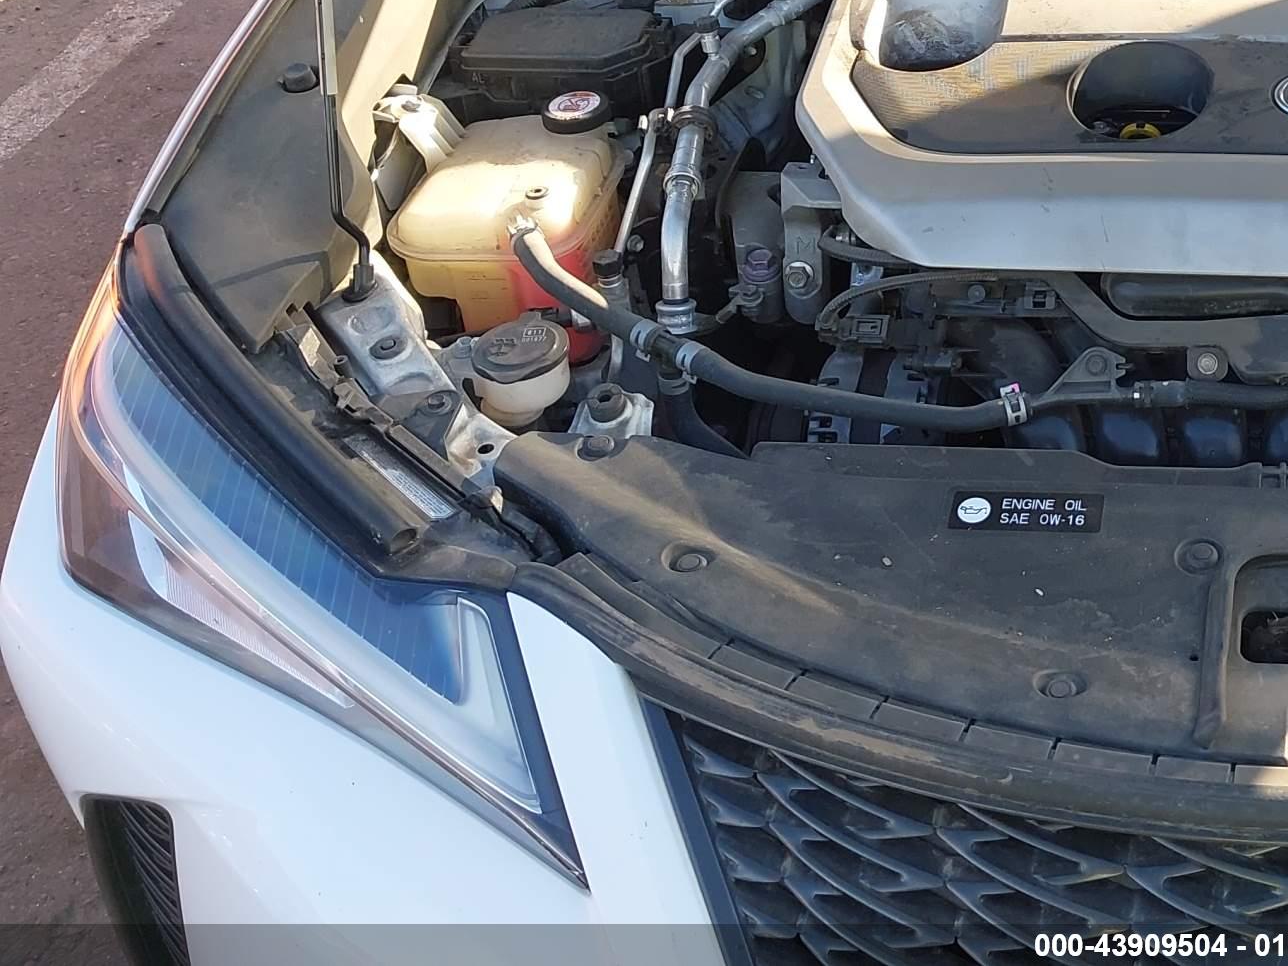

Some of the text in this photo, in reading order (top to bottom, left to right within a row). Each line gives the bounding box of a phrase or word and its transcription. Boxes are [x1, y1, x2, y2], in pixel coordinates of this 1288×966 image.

[1002, 499, 1086, 510] ENGINE OIL
[1000, 513, 1029, 524] SAE
